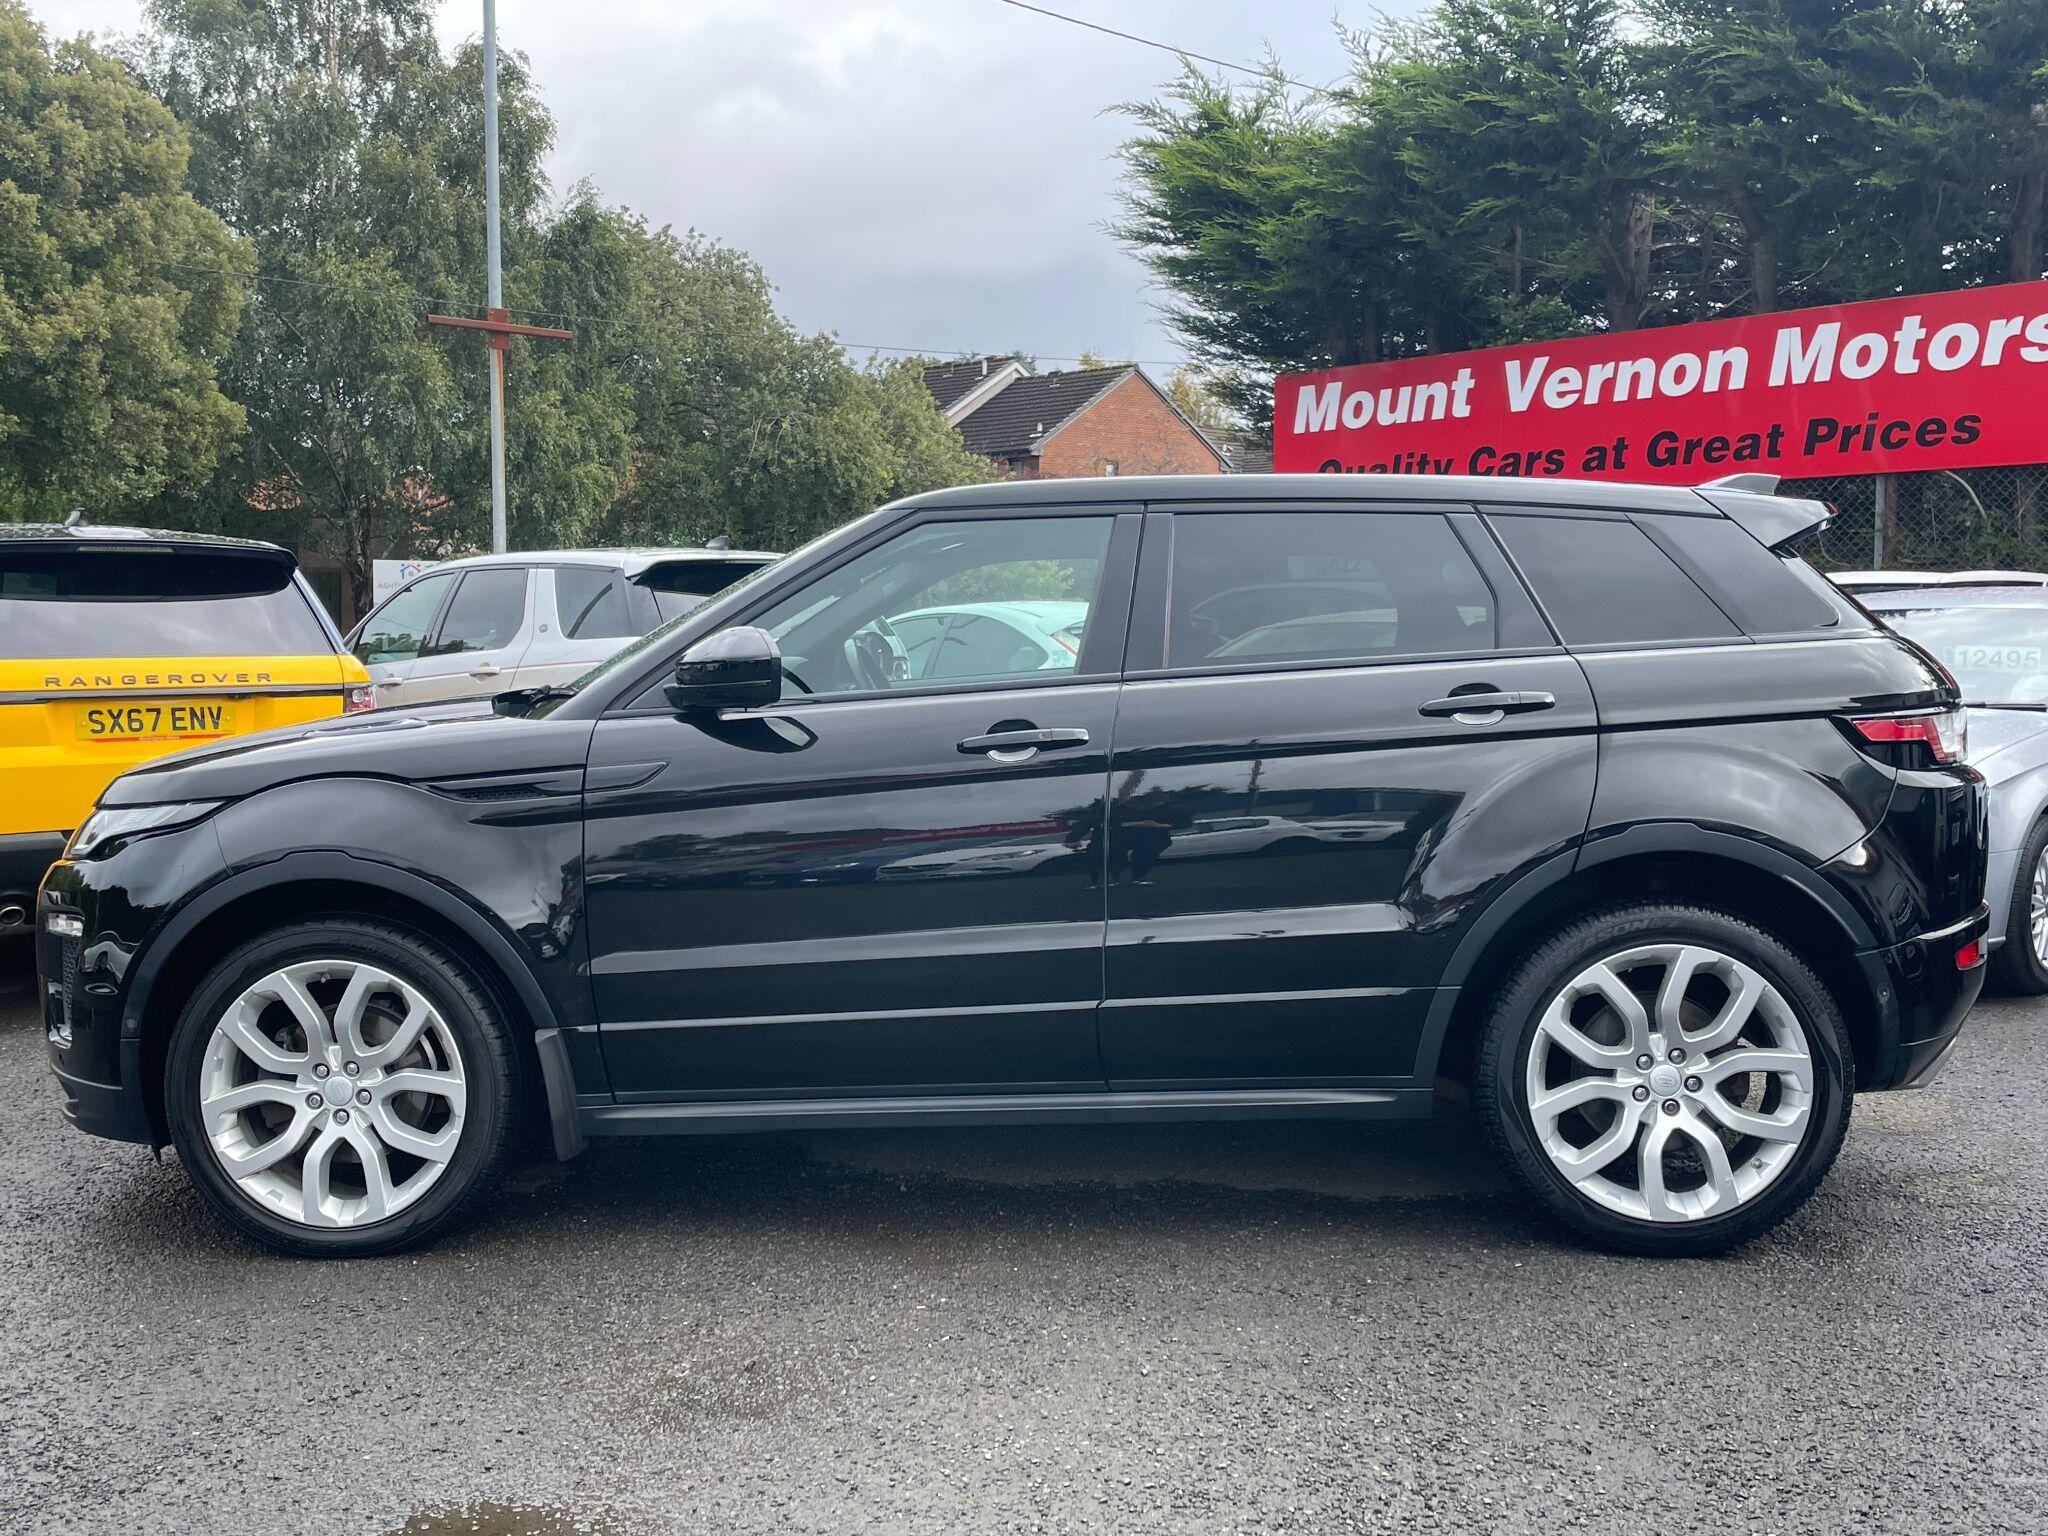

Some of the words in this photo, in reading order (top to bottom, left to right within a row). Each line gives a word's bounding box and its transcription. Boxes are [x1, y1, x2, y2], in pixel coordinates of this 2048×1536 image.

[1293, 368, 1476, 435] Mount
[1505, 345, 1749, 413] Vernon
[1768, 313, 2048, 387] Motors
[1468, 445, 1565, 477] Cars
[1582, 437, 1629, 471] at
[1646, 423, 1783, 468] Great
[1803, 412, 1983, 456] Prices
[87, 708, 161, 734] SX67
[170, 706, 222, 731] ENV
